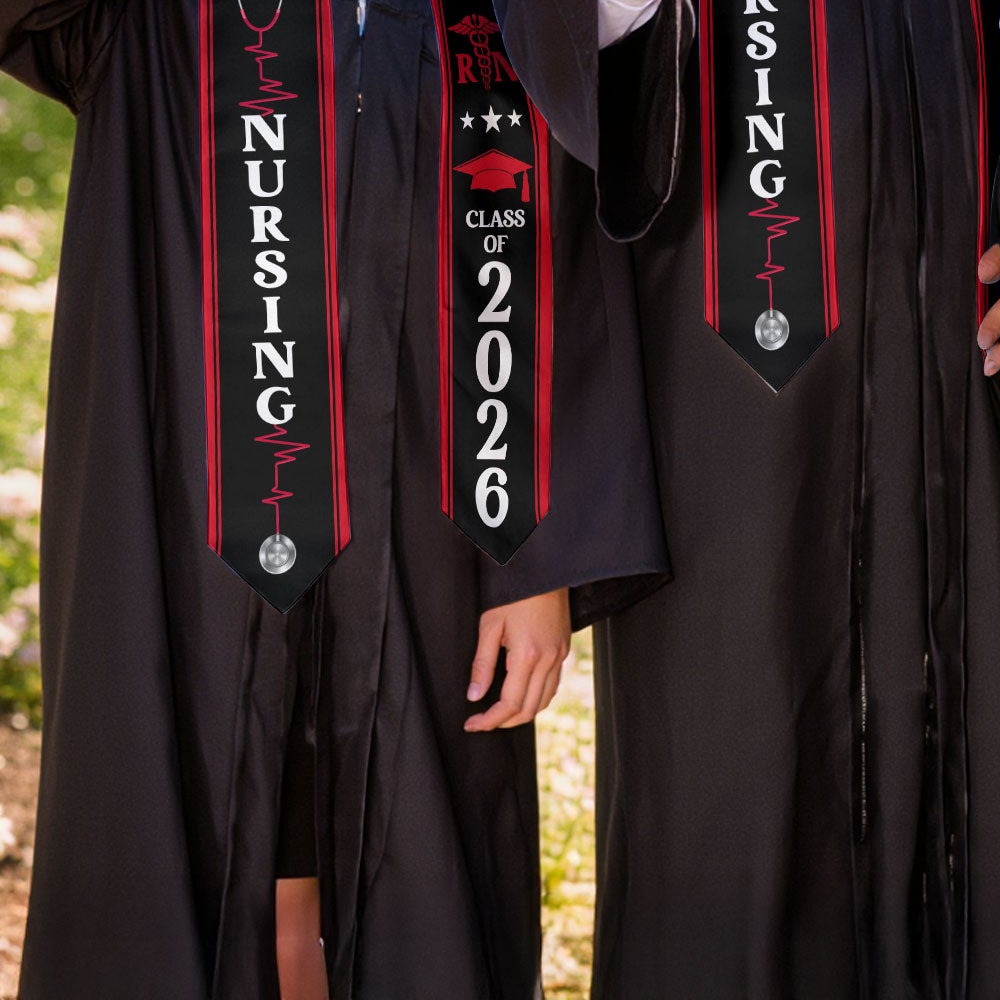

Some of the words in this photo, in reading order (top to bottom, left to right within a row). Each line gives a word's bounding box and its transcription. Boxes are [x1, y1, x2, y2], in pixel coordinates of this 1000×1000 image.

[241, 113, 297, 426] NURSING
[465, 209, 526, 228] CLASS
[483, 235, 508, 253] OF
[475, 260, 513, 528] 2026
